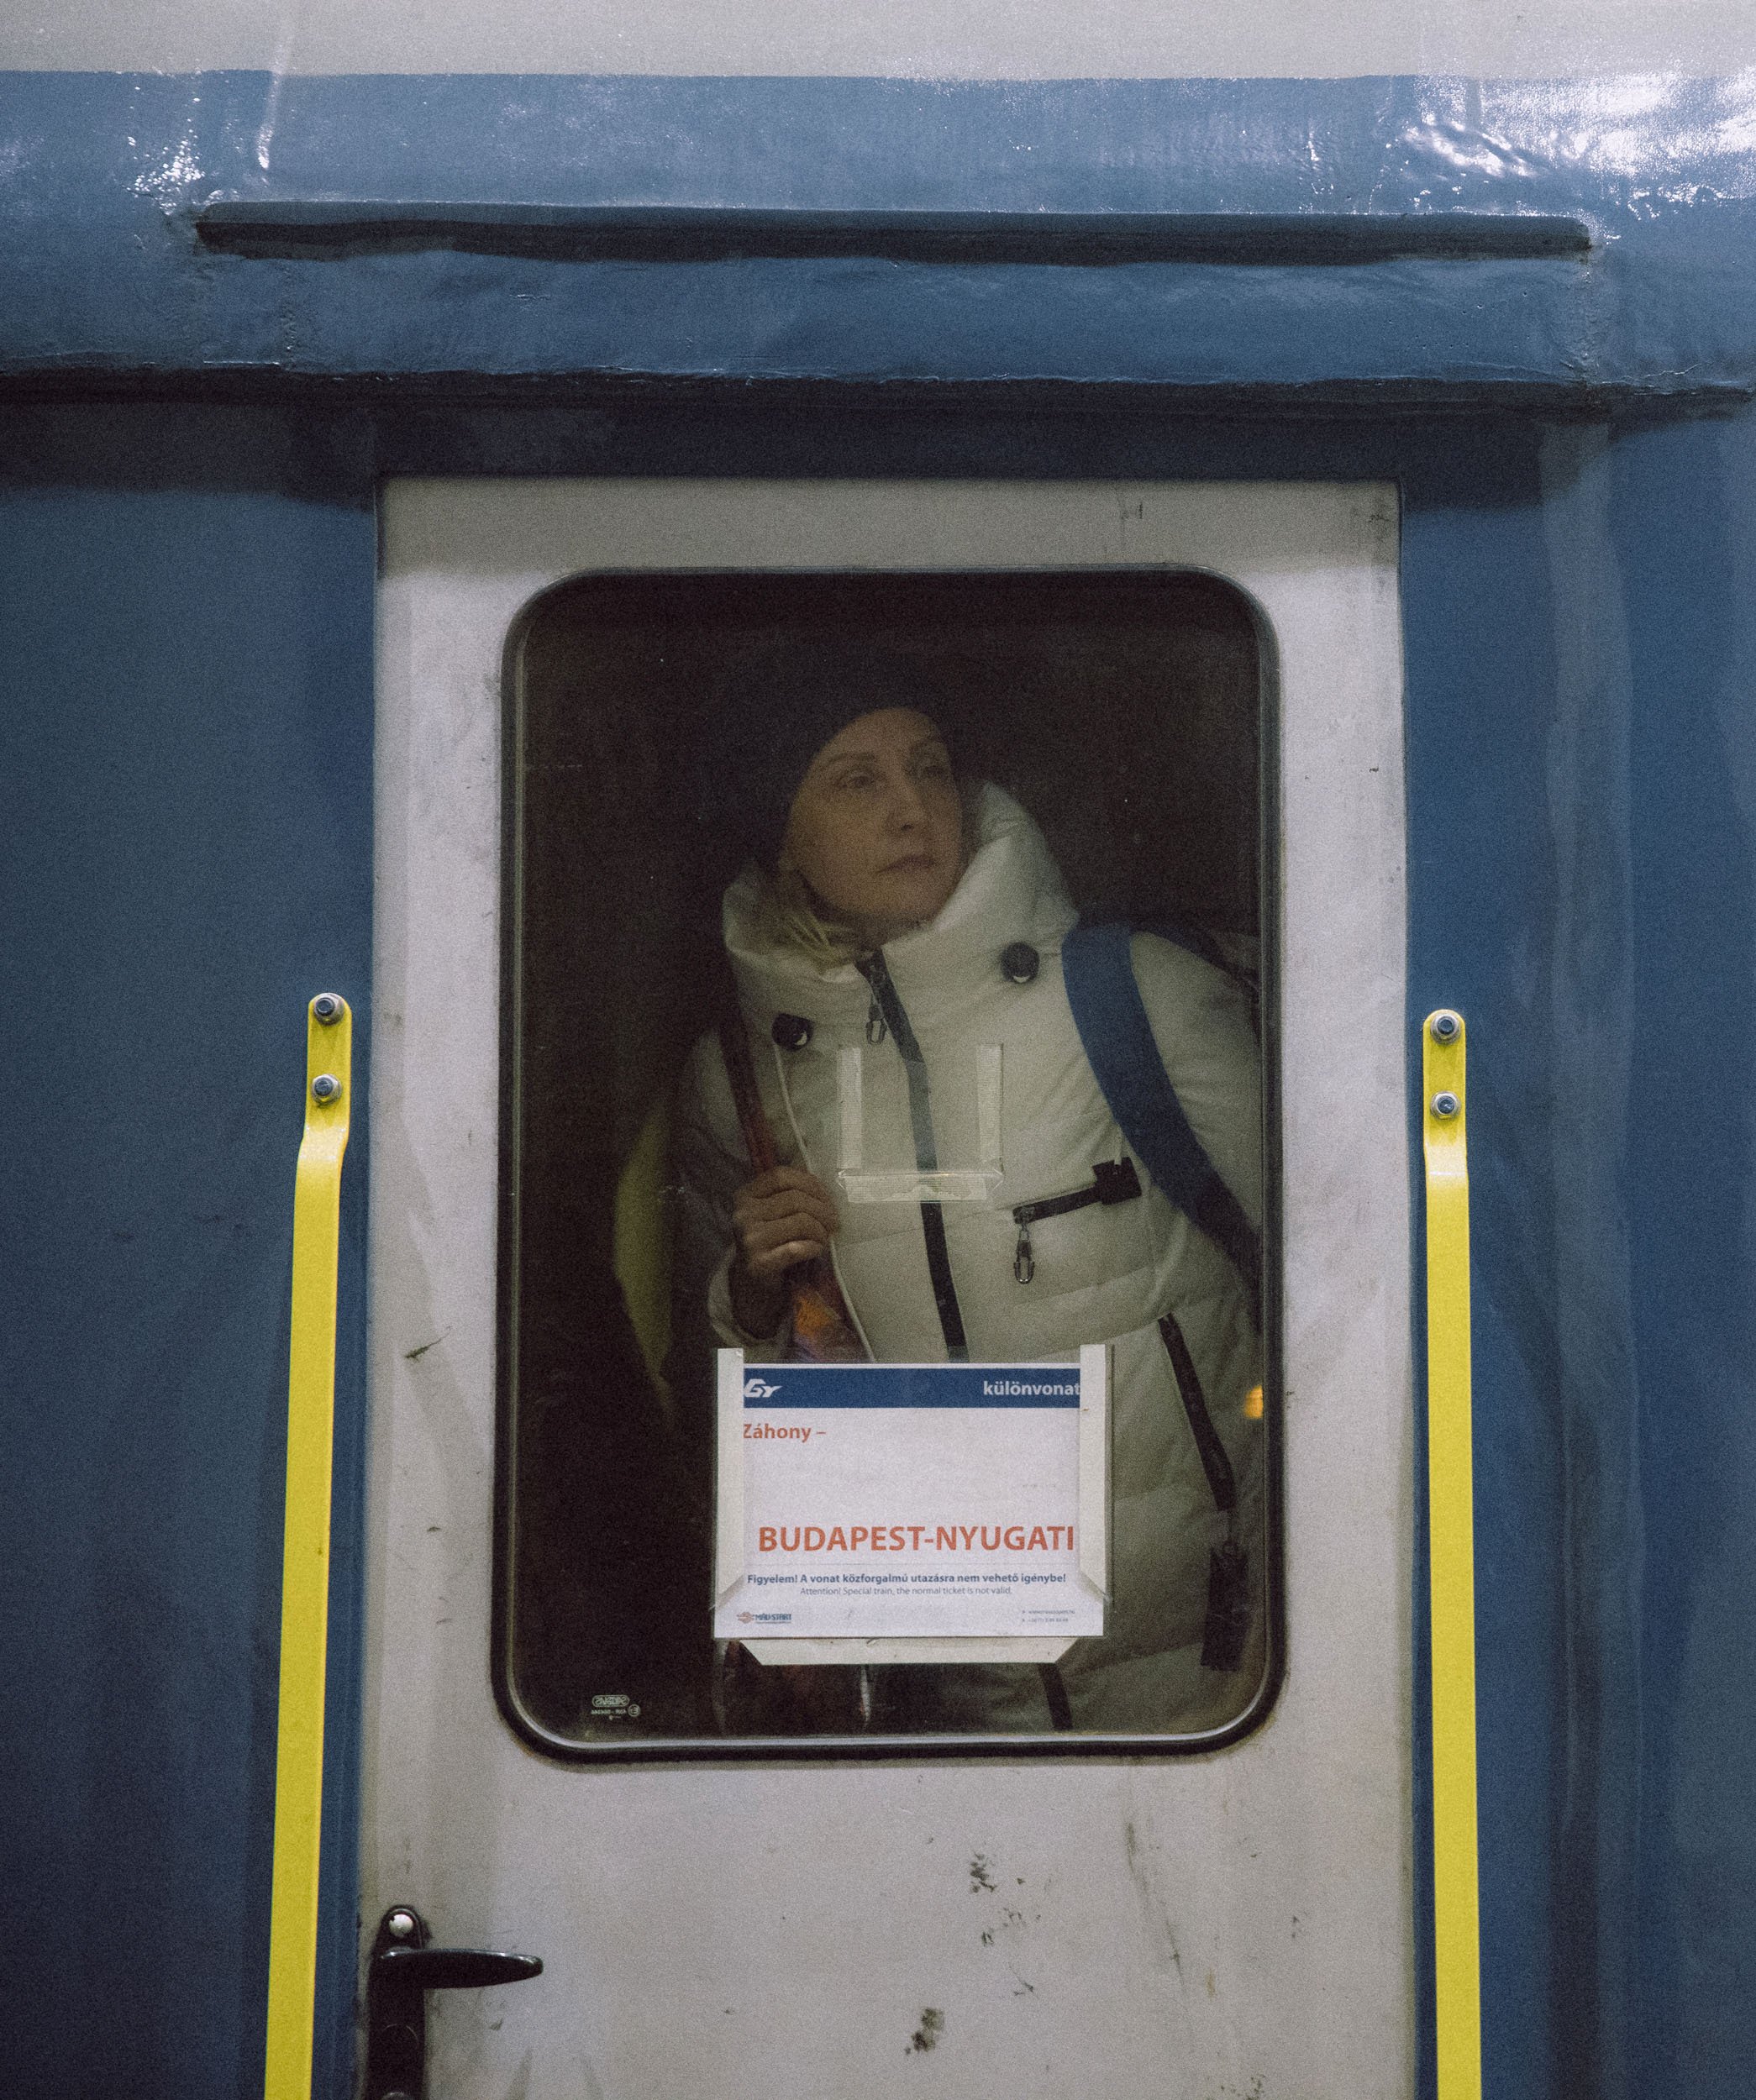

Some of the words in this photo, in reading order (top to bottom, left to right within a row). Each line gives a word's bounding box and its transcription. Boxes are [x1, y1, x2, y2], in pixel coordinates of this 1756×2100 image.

[983, 1380, 1080, 1395] különvonat
[744, 1423, 812, 1443] Záhony
[759, 1525, 1075, 1552] BUDAPEST-NYUGATI
[748, 1574, 798, 1586] Figyelem!
[800, 1574, 807, 1583] A
[810, 1574, 840, 1583] vonat
[843, 1573, 908, 1585] közforgalmú
[911, 1573, 955, 1583] utazásra
[982, 1573, 1019, 1583] vehető
[1021, 1573, 1066, 1585] igénybe!
[843, 1587, 872, 1595] Special
[874, 1587, 895, 1596] train,
[943, 1586, 965, 1594] ticket
